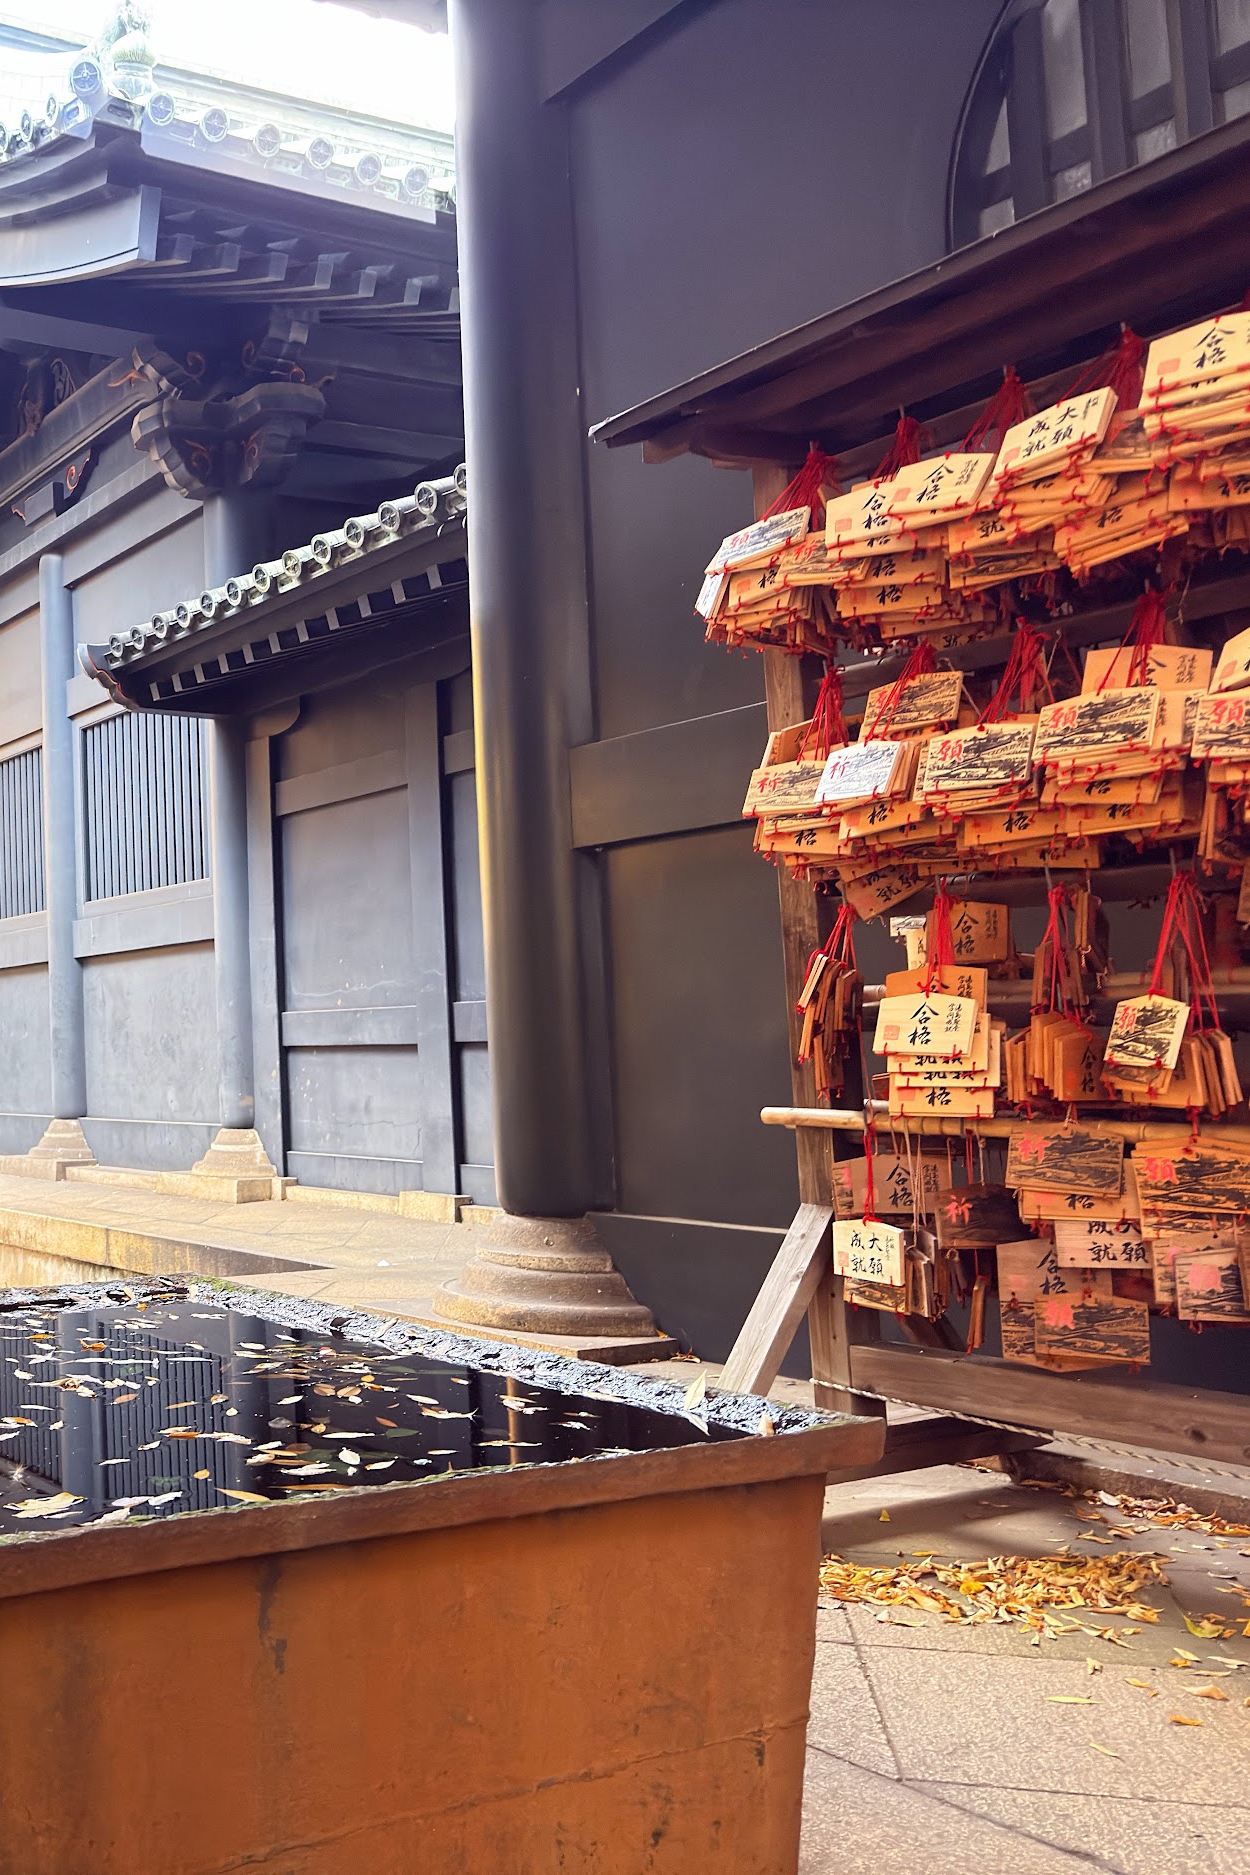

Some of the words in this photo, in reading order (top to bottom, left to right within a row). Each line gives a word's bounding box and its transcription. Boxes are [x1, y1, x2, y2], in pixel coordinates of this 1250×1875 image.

[1193, 327, 1236, 368] 合格
[916, 463, 954, 503] 合格
[861, 492, 888, 530] 合格
[1050, 705, 1077, 729] 願
[1208, 700, 1245, 726] 願
[830, 755, 849, 779] 祈
[937, 739, 963, 762] 願
[758, 771, 782, 793] 祈
[954, 911, 979, 955] 合格
[908, 1002, 939, 1046] 合格
[1119, 1005, 1138, 1033] 願
[886, 1164, 913, 1207] 合格
[850, 1230, 867, 1274] 成就
[867, 1232, 884, 1277] 大願
